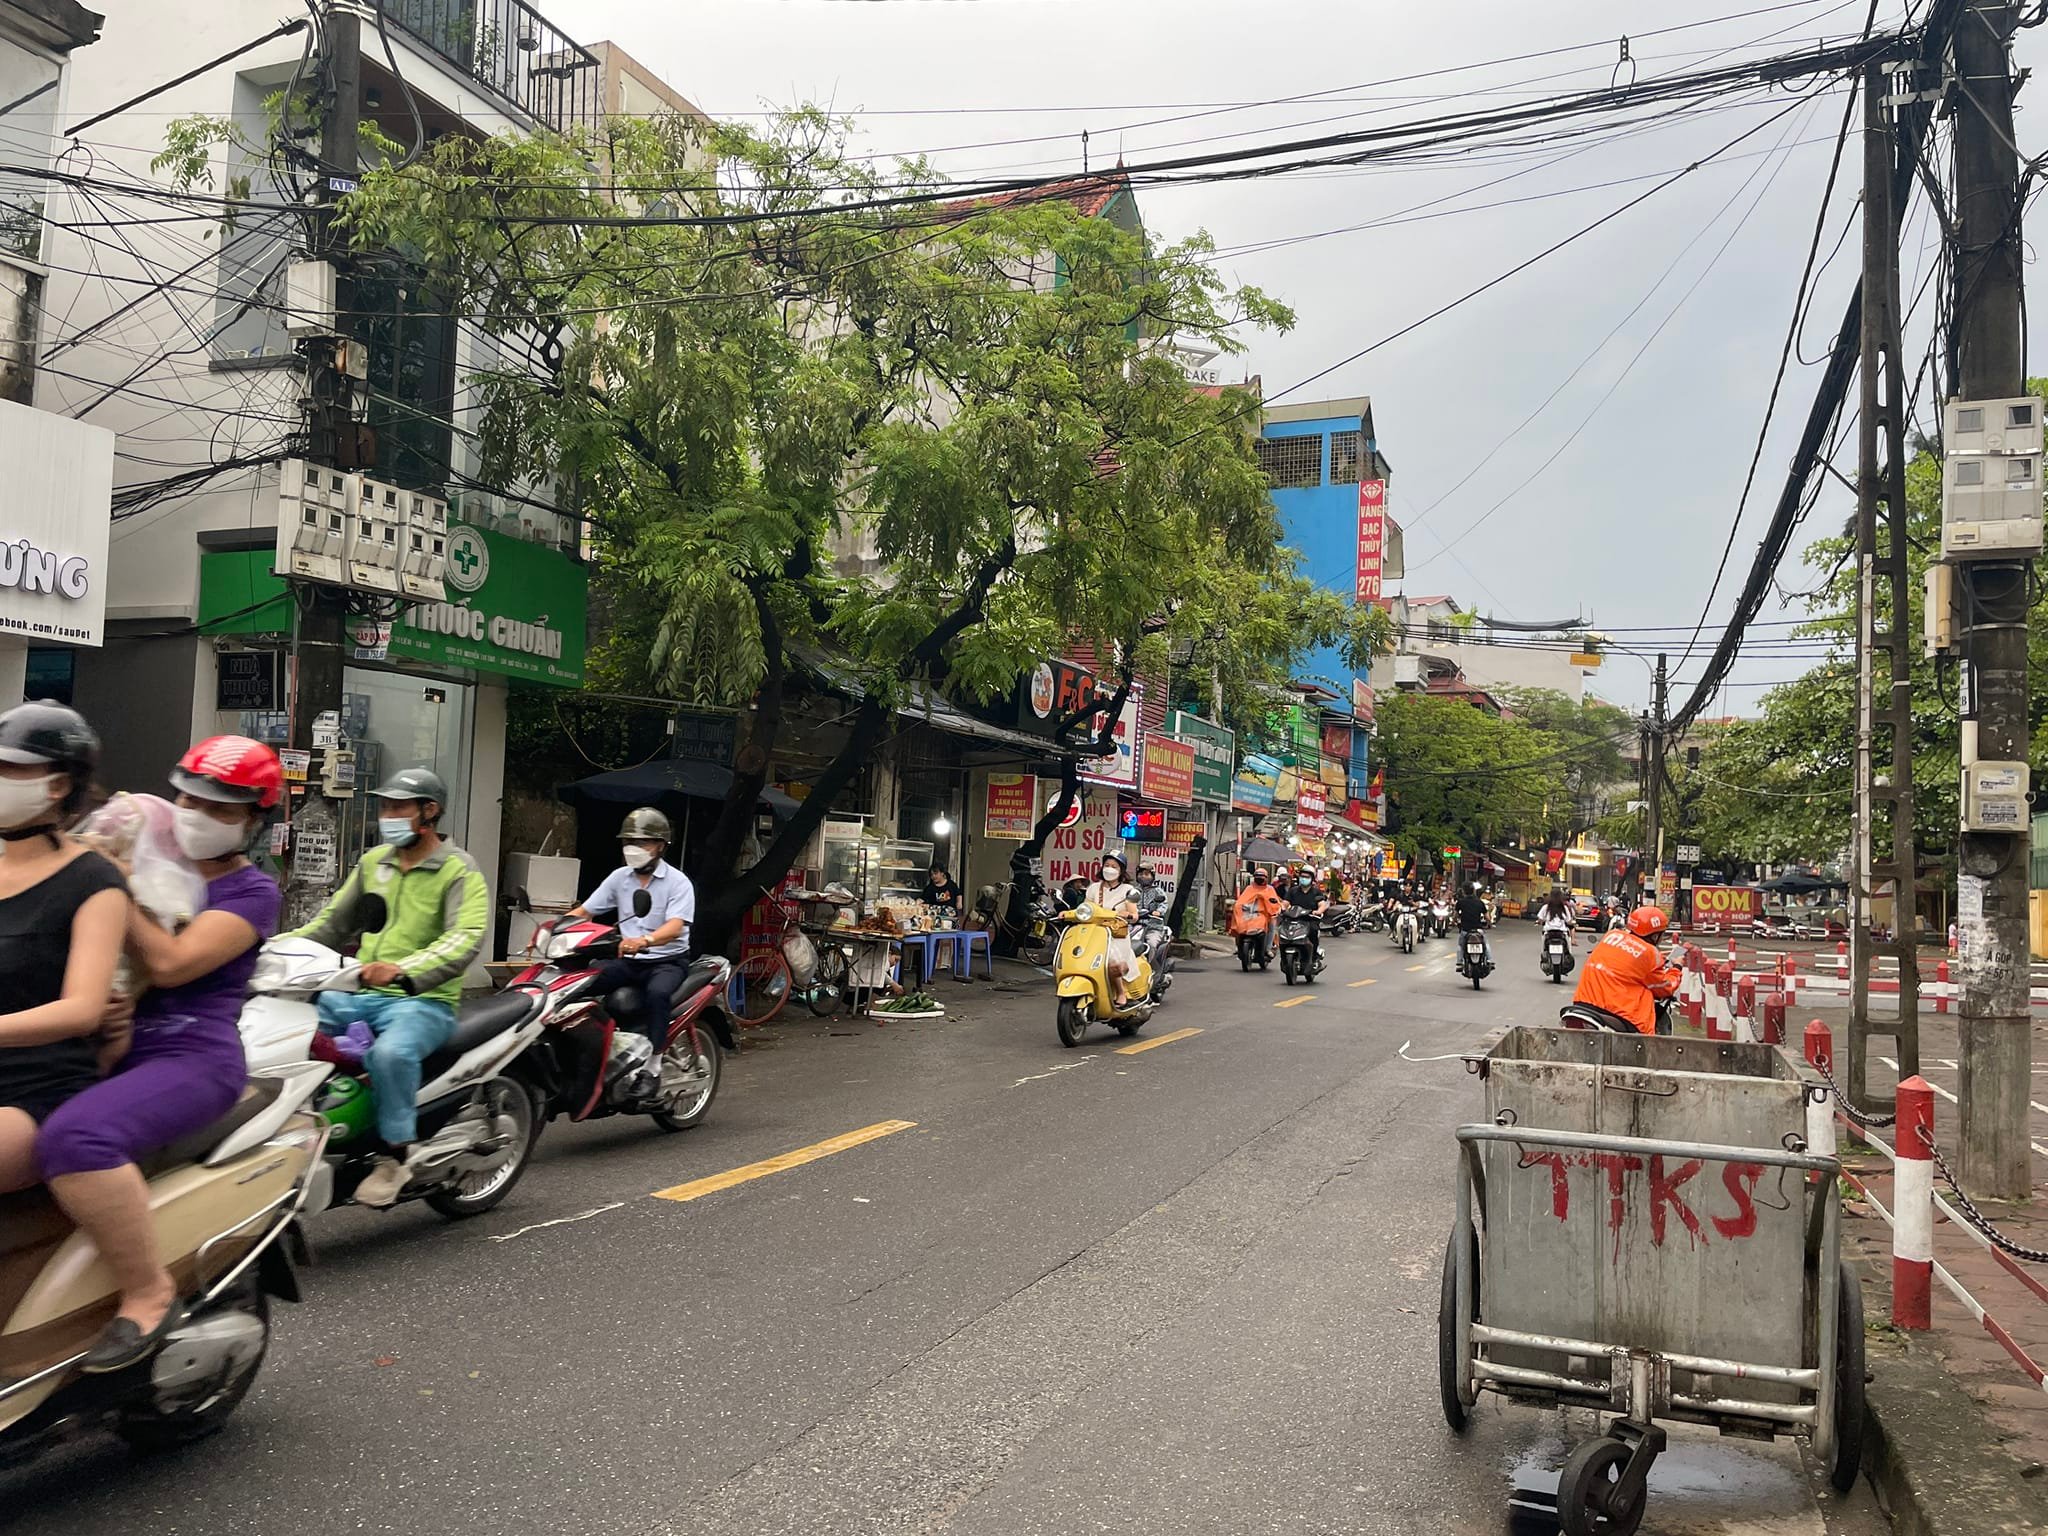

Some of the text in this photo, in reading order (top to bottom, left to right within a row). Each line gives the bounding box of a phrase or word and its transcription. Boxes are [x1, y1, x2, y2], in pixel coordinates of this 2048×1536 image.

[1360, 503, 1383, 518] VÀNG
[1362, 522, 1380, 538] BẠC
[1360, 557, 1380, 571] LINH
[1358, 576, 1380, 596] 276
[489, 614, 563, 660] CHUẨN
[1082, 822, 1106, 851] SỐ
[1168, 823, 1204, 833] KHUNG
[1142, 844, 1177, 859] KHUNG
[1049, 855, 1073, 881] HÀ
[1695, 888, 1751, 912] CƠM
